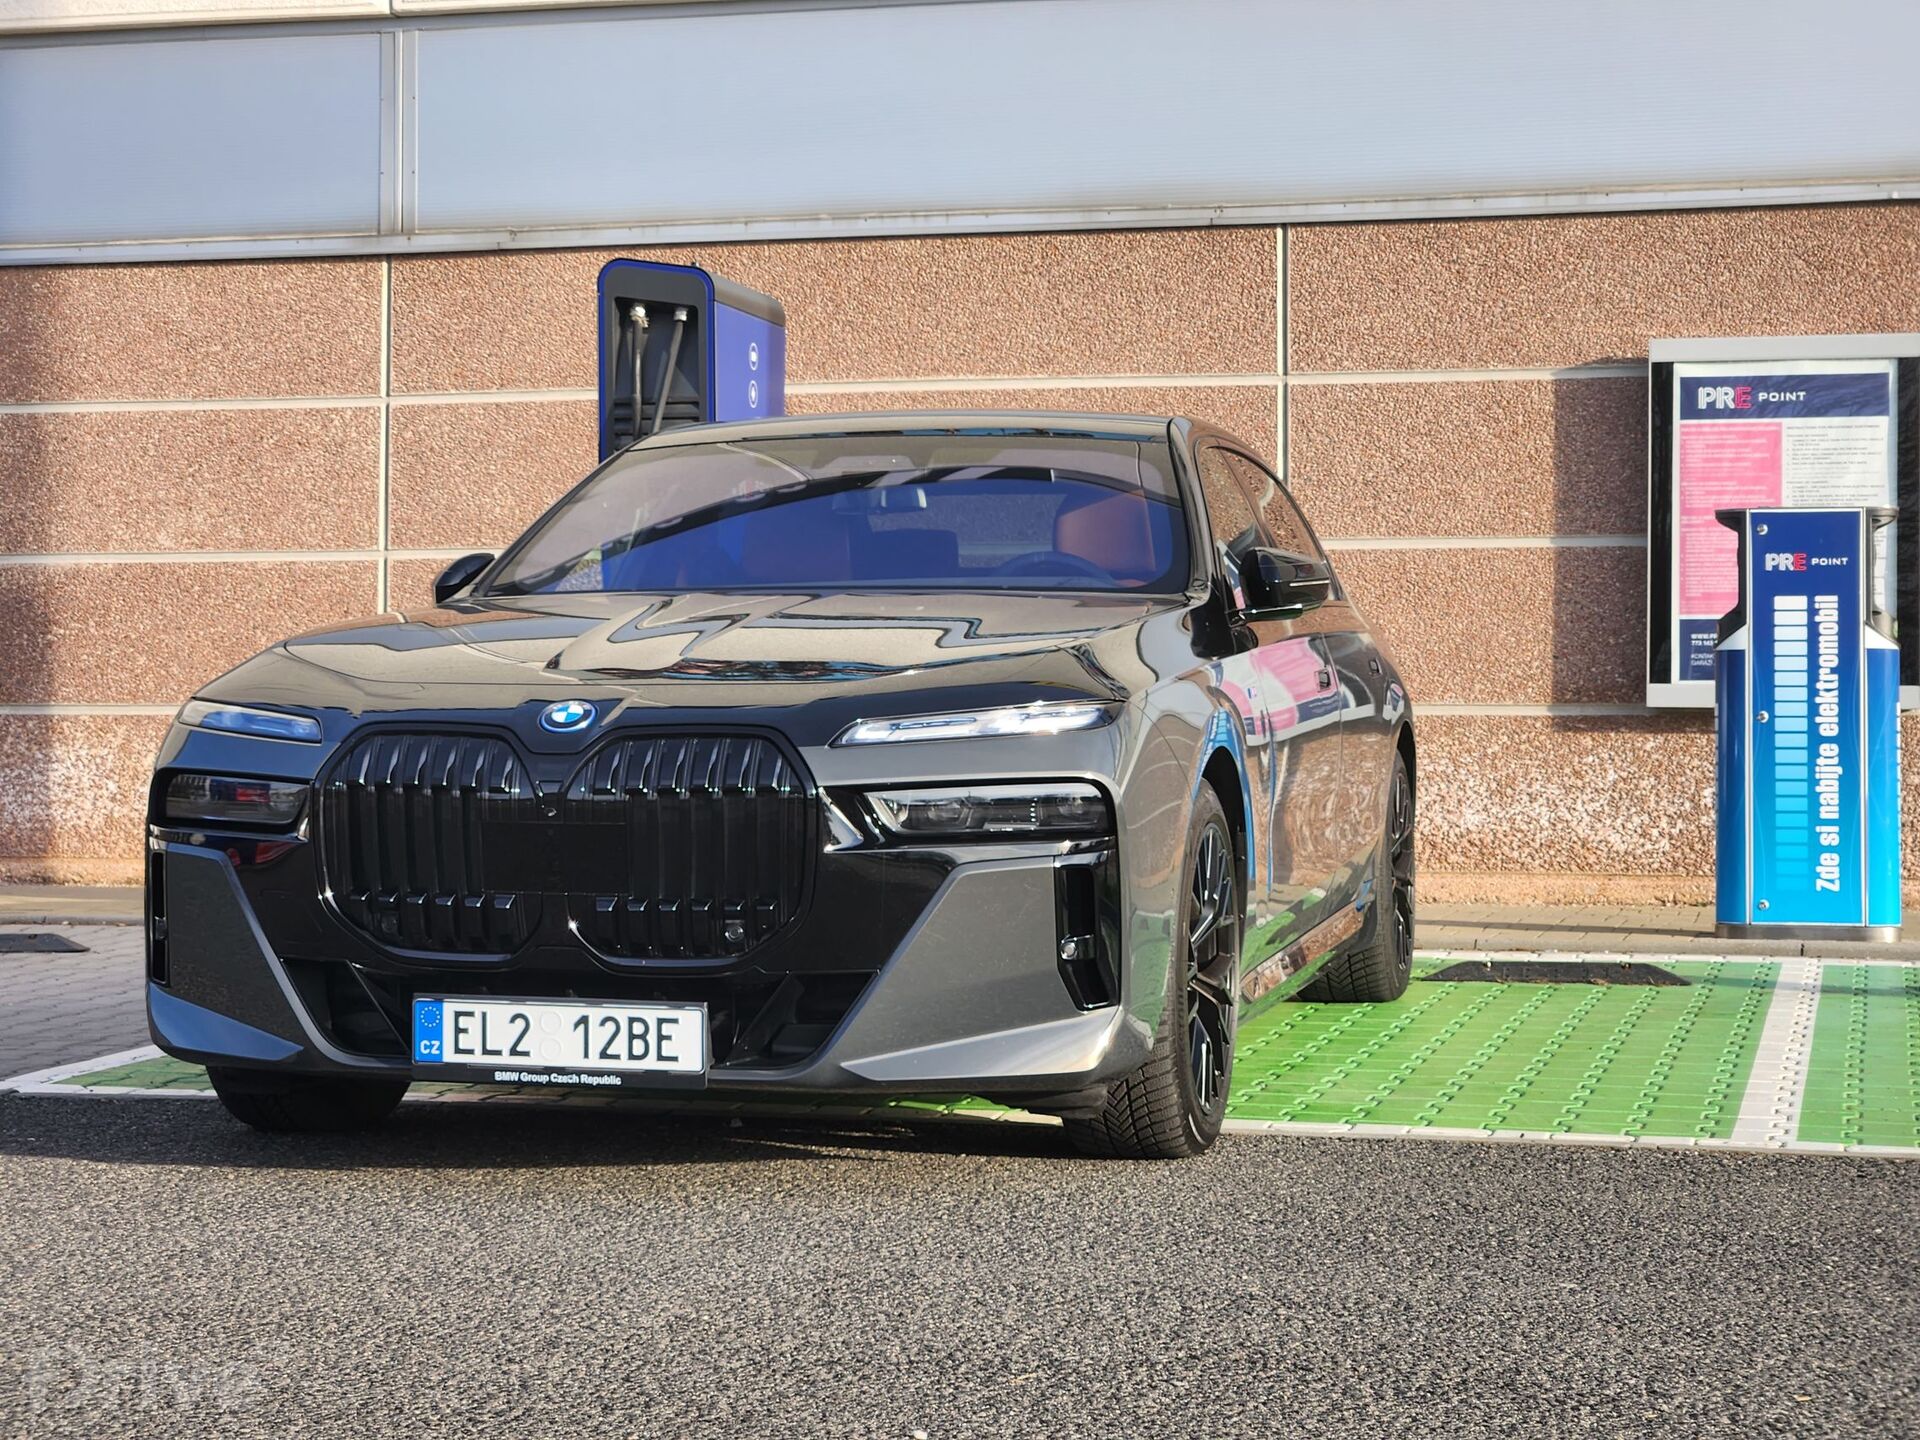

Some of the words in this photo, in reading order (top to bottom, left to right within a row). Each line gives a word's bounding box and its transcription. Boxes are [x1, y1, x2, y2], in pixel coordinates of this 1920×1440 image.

[1697, 386, 1752, 410] PRE
[1758, 391, 1807, 402] POINT
[1764, 552, 1808, 572] PRE
[1811, 556, 1849, 566] POINT
[1814, 595, 1839, 737] elektromobil
[1814, 743, 1843, 819] nabijte
[1815, 825, 1840, 847] si
[1815, 852, 1840, 892] Zde
[419, 1039, 441, 1055] CZ
[453, 1010, 531, 1057] EL2
[573, 1014, 680, 1062] 12BE
[494, 1071, 519, 1081] BMW
[520, 1072, 550, 1085] Group
[550, 1073, 579, 1083] Czech
[580, 1073, 622, 1086] Republic
